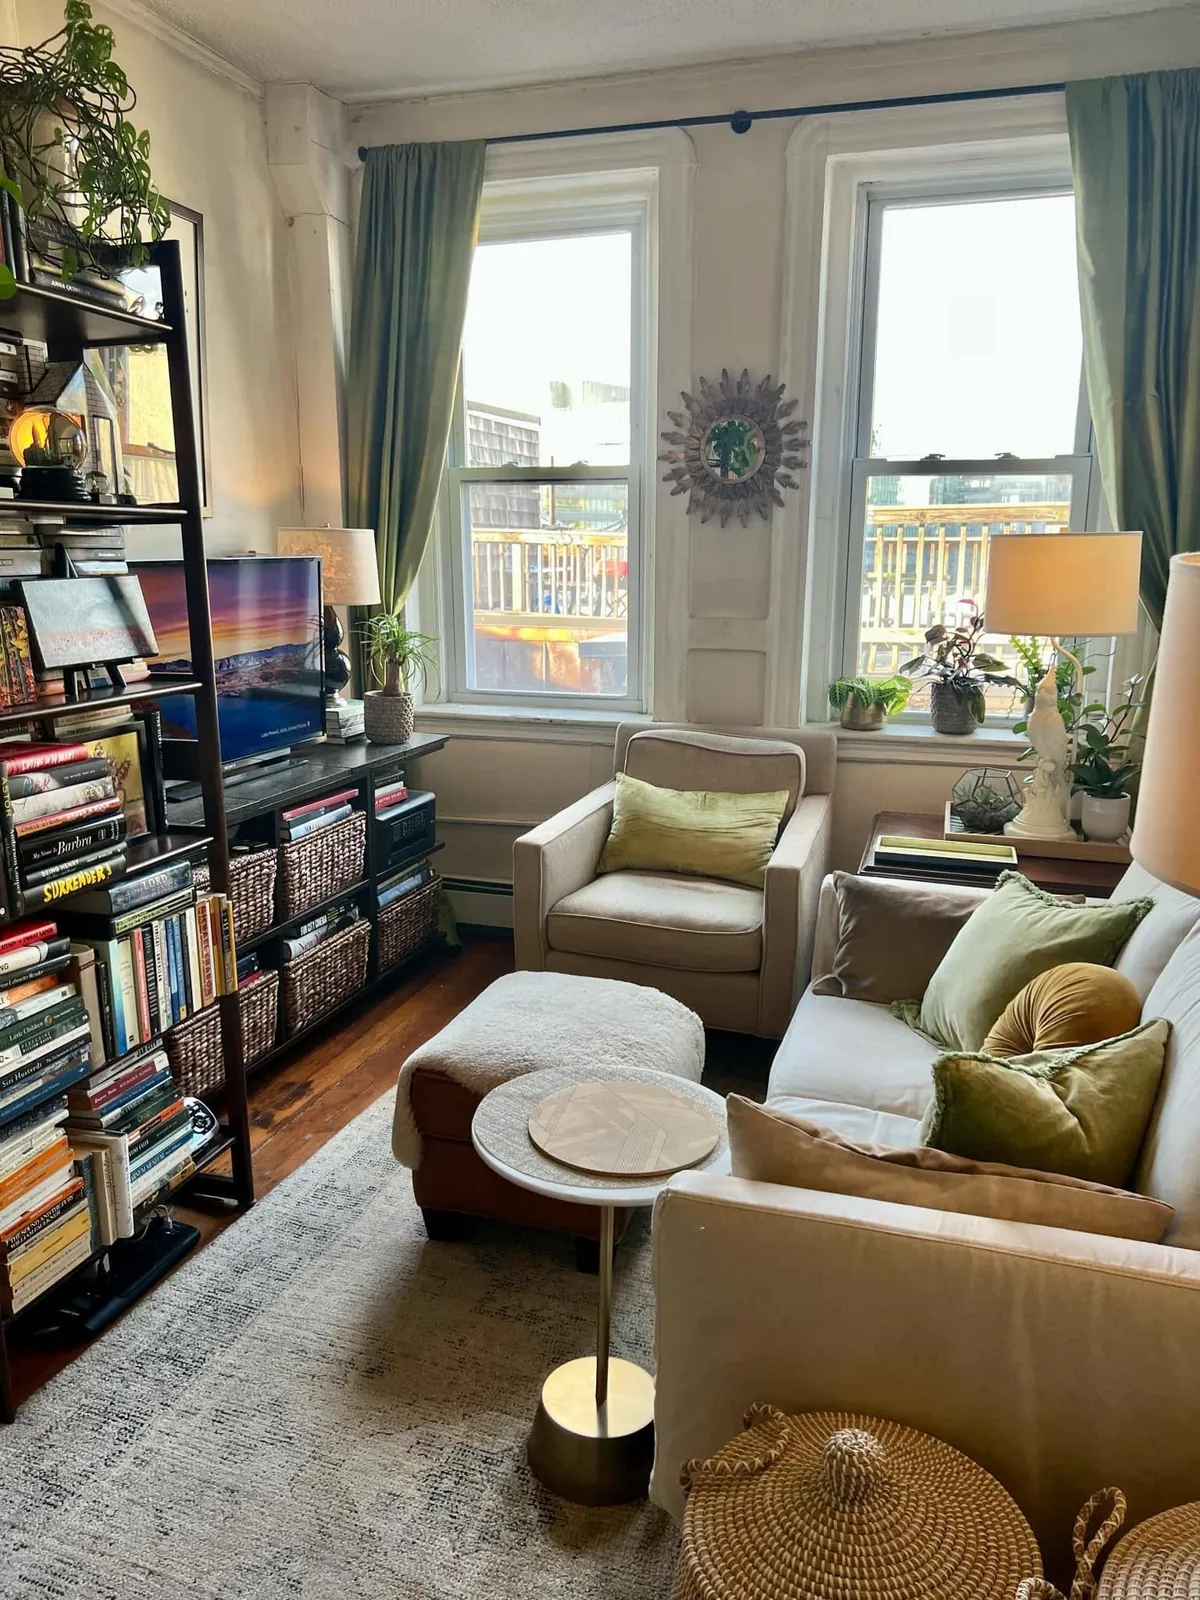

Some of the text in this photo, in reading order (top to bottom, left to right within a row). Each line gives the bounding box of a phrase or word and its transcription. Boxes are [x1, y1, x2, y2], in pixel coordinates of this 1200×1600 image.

[1, 777, 12, 817] ASTOR
[10, 829, 19, 866] Anderson
[32, 852, 40, 860] My
[57, 835, 92, 856] Barbra
[41, 866, 60, 877] BEING
[60, 858, 79, 871] HENRY
[142, 872, 168, 889] LORD
[43, 865, 105, 903] SURRENDER
[9, 1021, 43, 1042] Little Children
[2, 1061, 43, 1088] Siri Hustvedt
